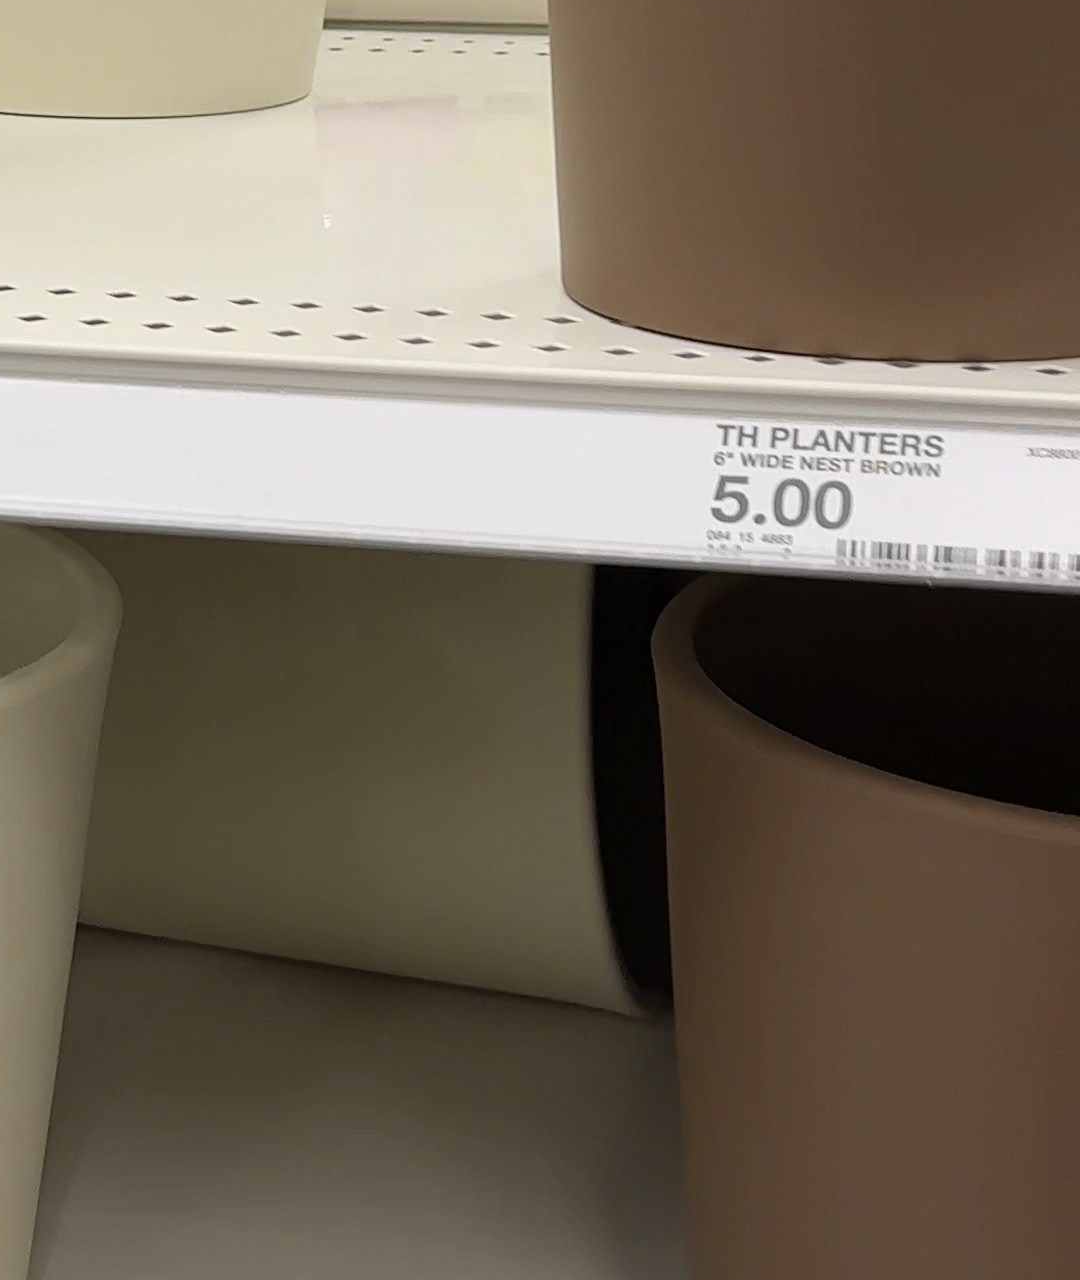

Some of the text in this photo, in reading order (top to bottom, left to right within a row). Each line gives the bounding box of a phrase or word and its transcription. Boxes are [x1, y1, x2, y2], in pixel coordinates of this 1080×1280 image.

[716, 423, 944, 458] TH PLANTERS
[713, 451, 941, 478] 6" WIDE NEST BROWN
[710, 475, 852, 529] 5.00
